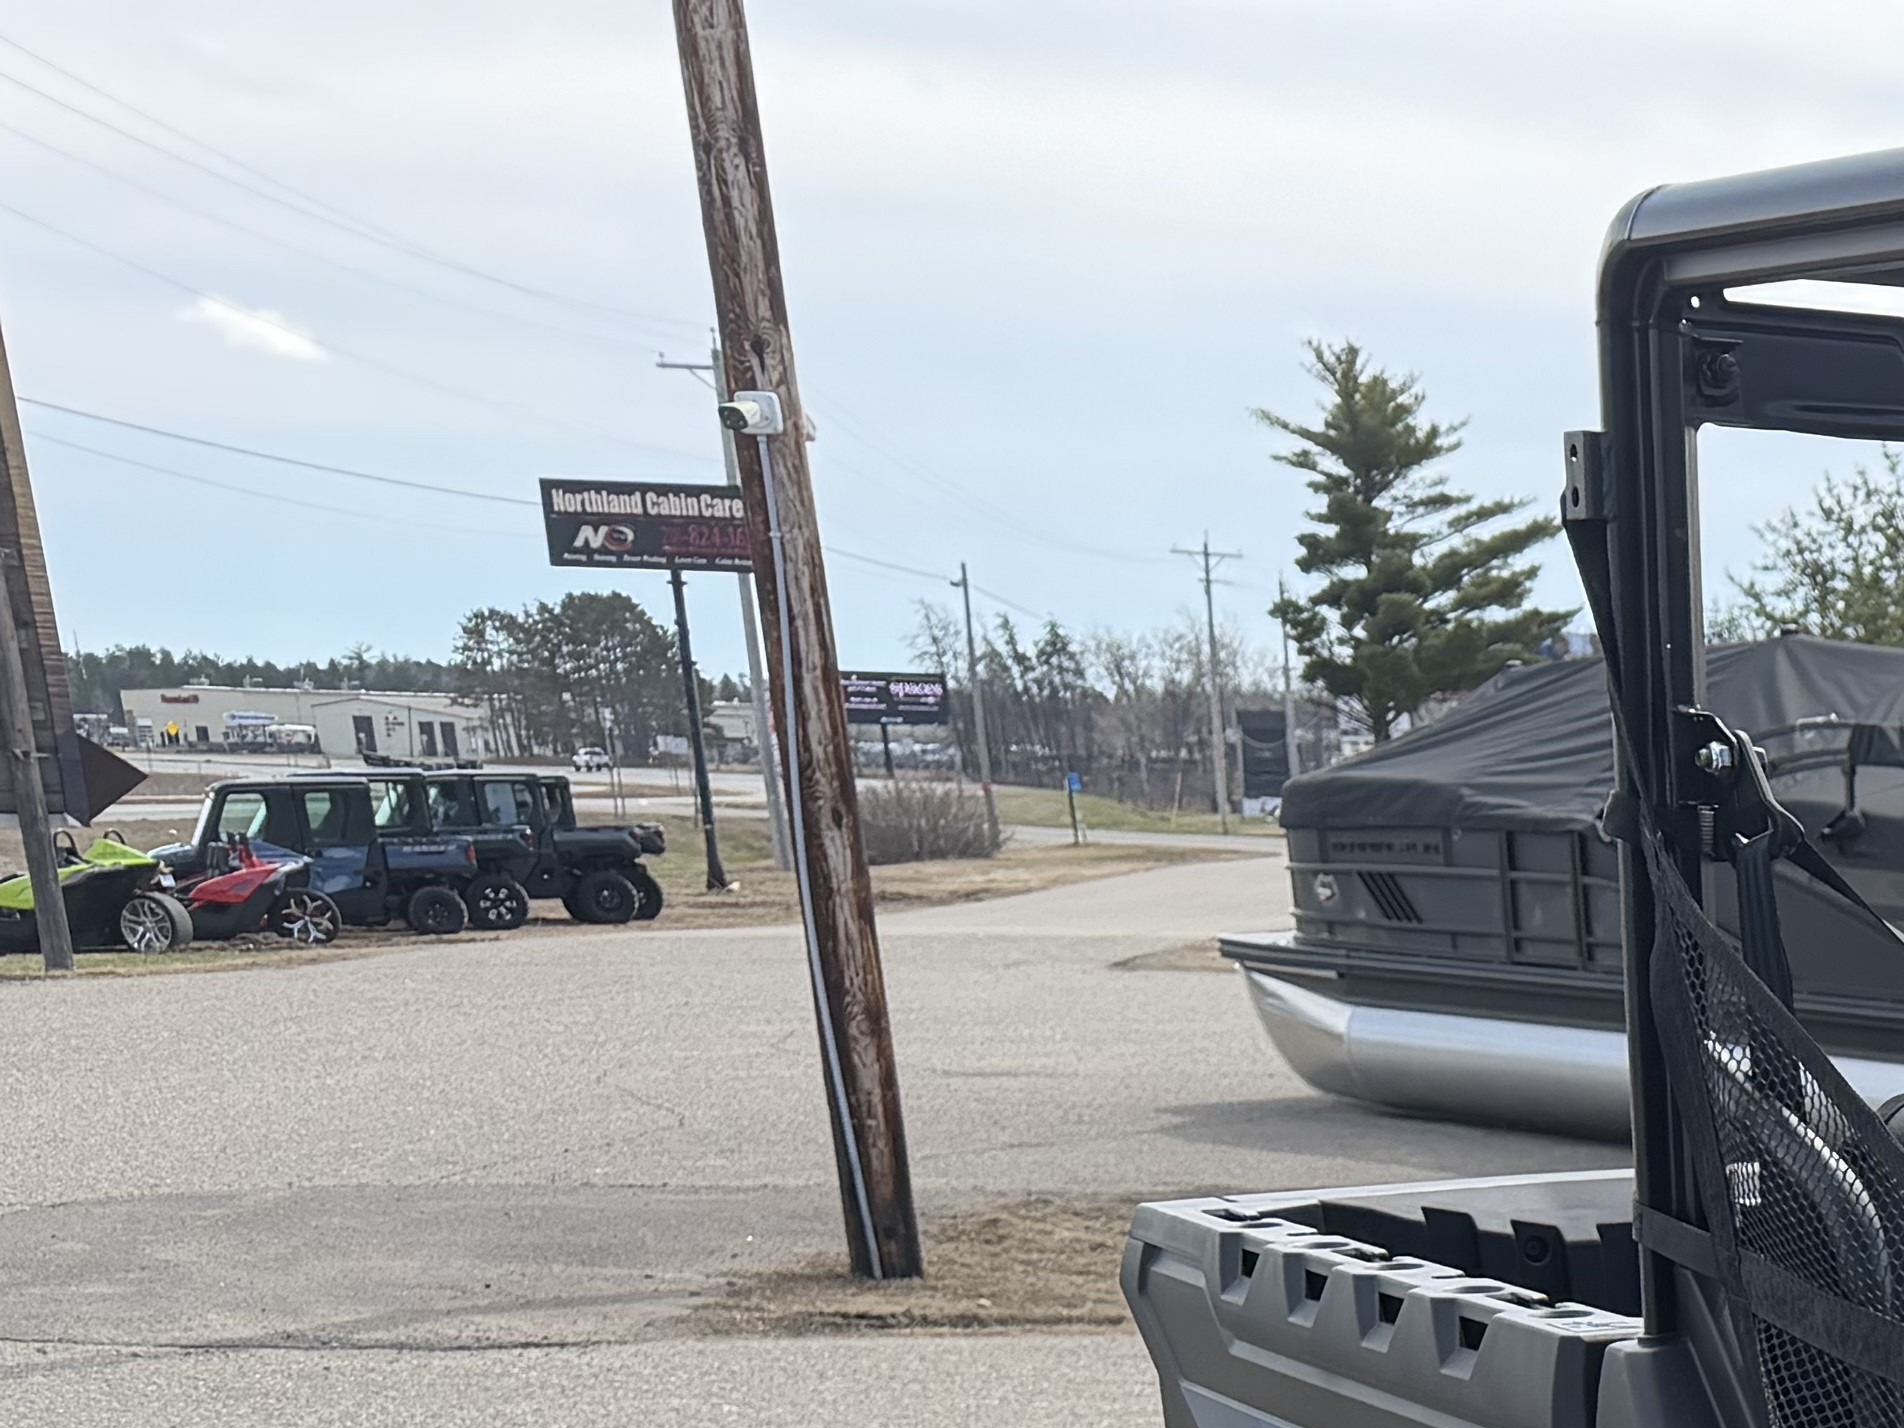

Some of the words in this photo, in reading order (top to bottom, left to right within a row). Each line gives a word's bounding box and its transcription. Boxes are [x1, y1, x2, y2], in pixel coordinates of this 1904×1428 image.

[551, 488, 644, 515] Northland
[645, 491, 699, 516] Cabin
[700, 493, 744, 518] Care
